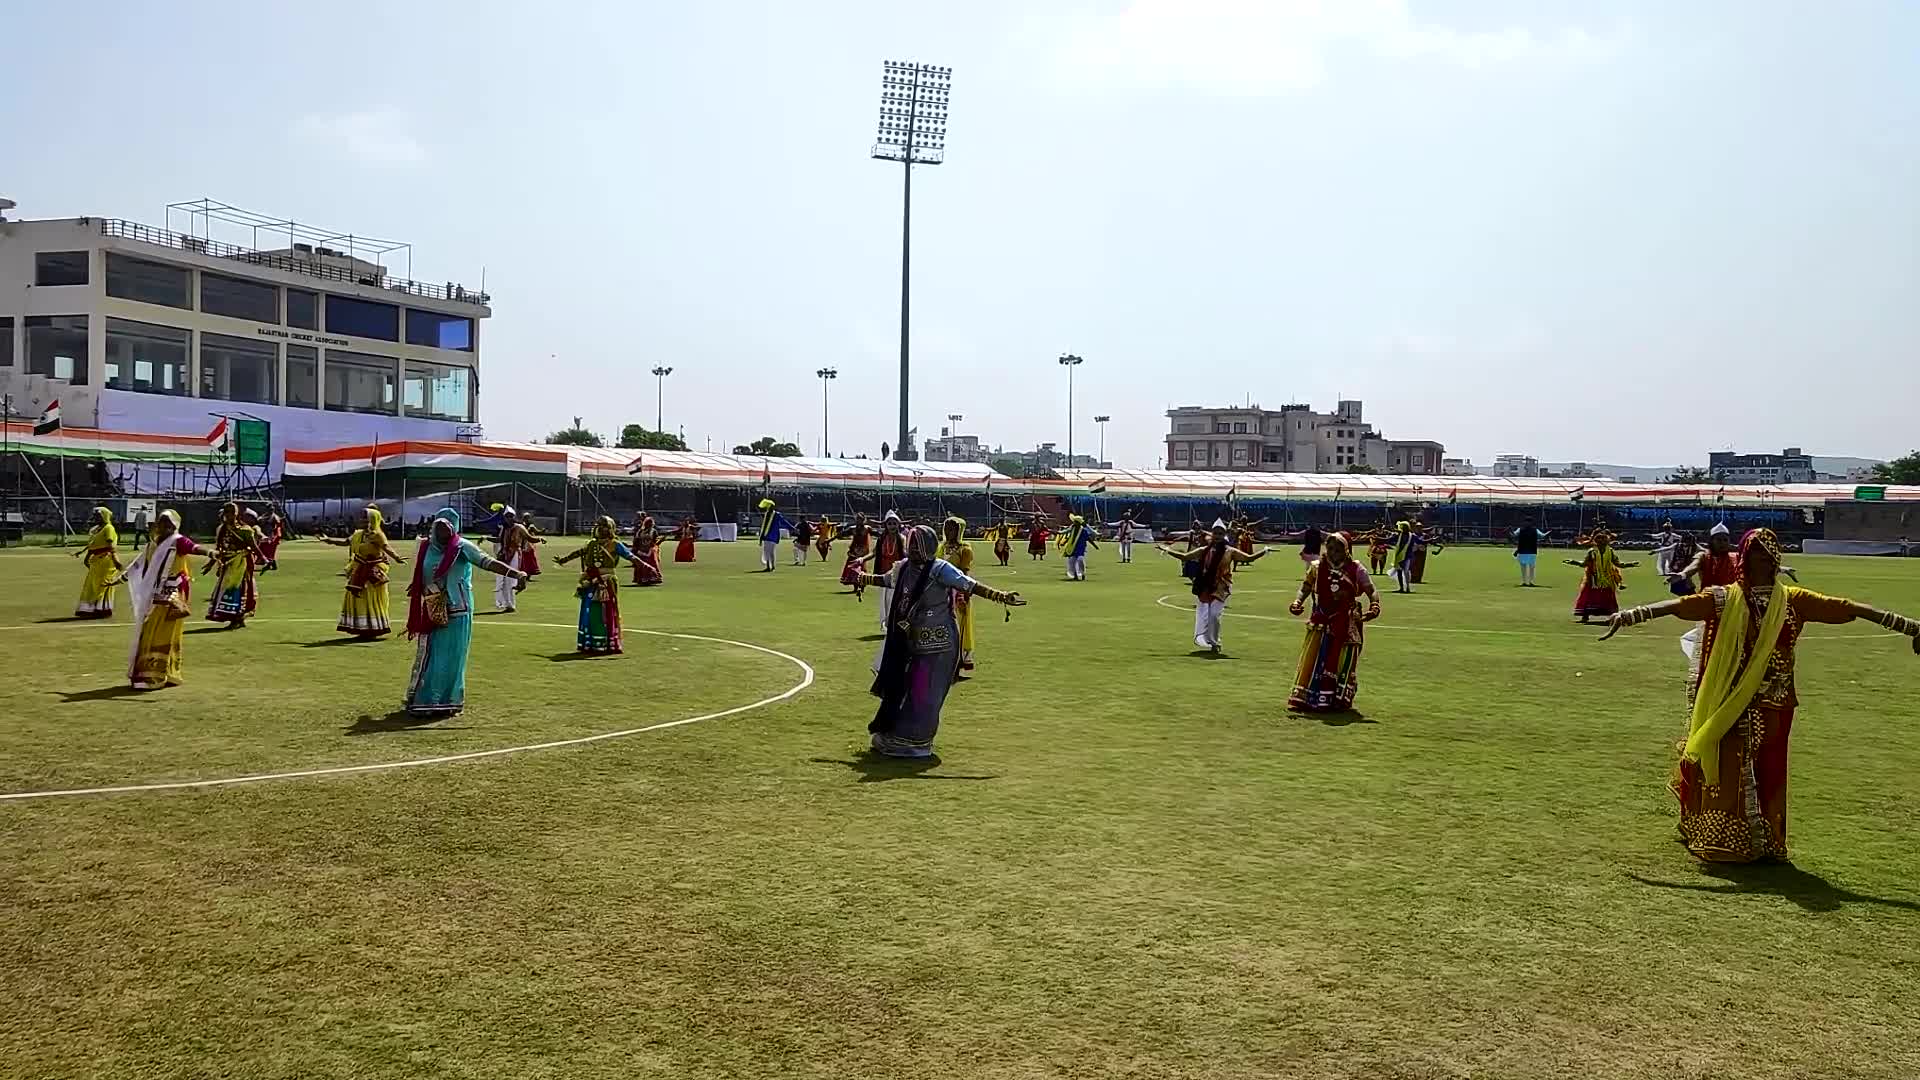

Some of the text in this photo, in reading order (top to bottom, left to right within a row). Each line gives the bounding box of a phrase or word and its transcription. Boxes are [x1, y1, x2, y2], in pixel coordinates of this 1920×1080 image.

[258, 328, 349, 346] RAJASTHAN CRICKET ASSOCIATION
